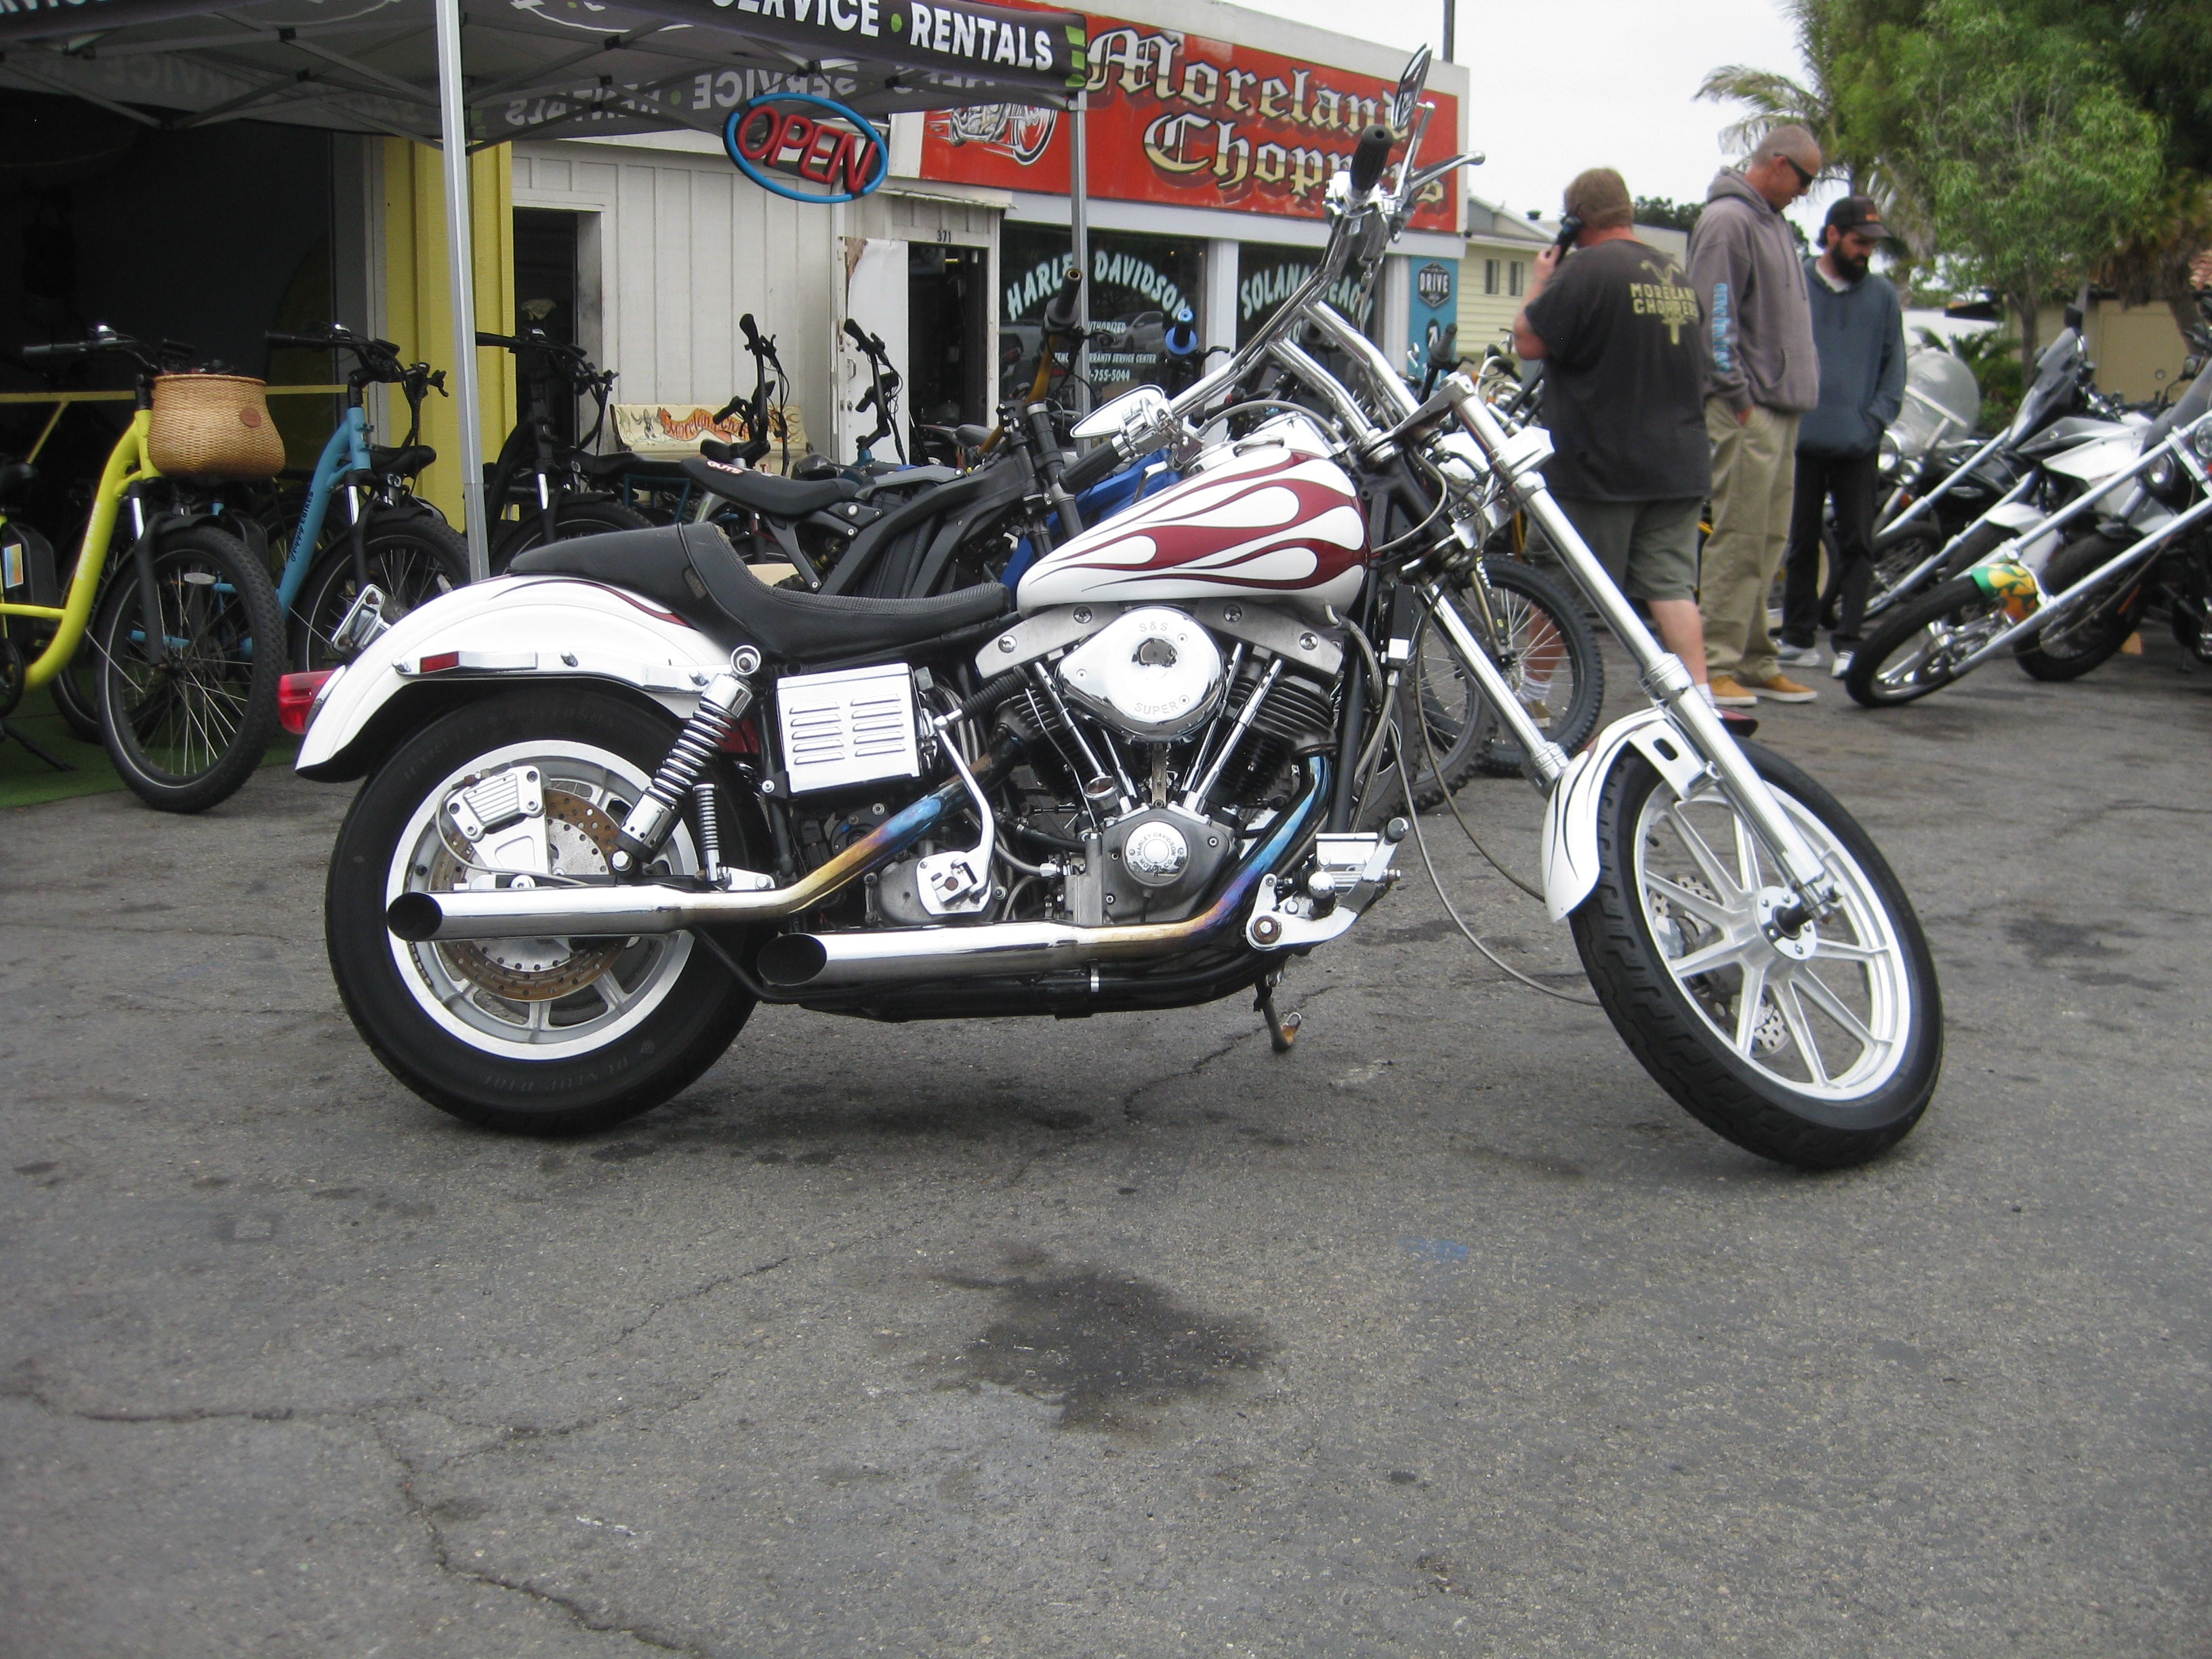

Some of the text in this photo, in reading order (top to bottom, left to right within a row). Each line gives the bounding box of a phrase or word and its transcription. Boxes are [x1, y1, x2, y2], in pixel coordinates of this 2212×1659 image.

[713, 0, 1053, 70] VICE RENTALS
[737, 104, 878, 192] OPEN
[1143, 112, 1444, 203] Chops
[937, 230, 951, 243] 371
[1006, 251, 1073, 322] HARLE
[1419, 272, 1448, 292] DRIVE
[1088, 321, 1126, 334] UTHORIZED
[1089, 353, 1157, 364] RRANTY SERVICE CENTER
[1089, 369, 1130, 382] -755-5044
[1134, 701, 1179, 715] SUPER
